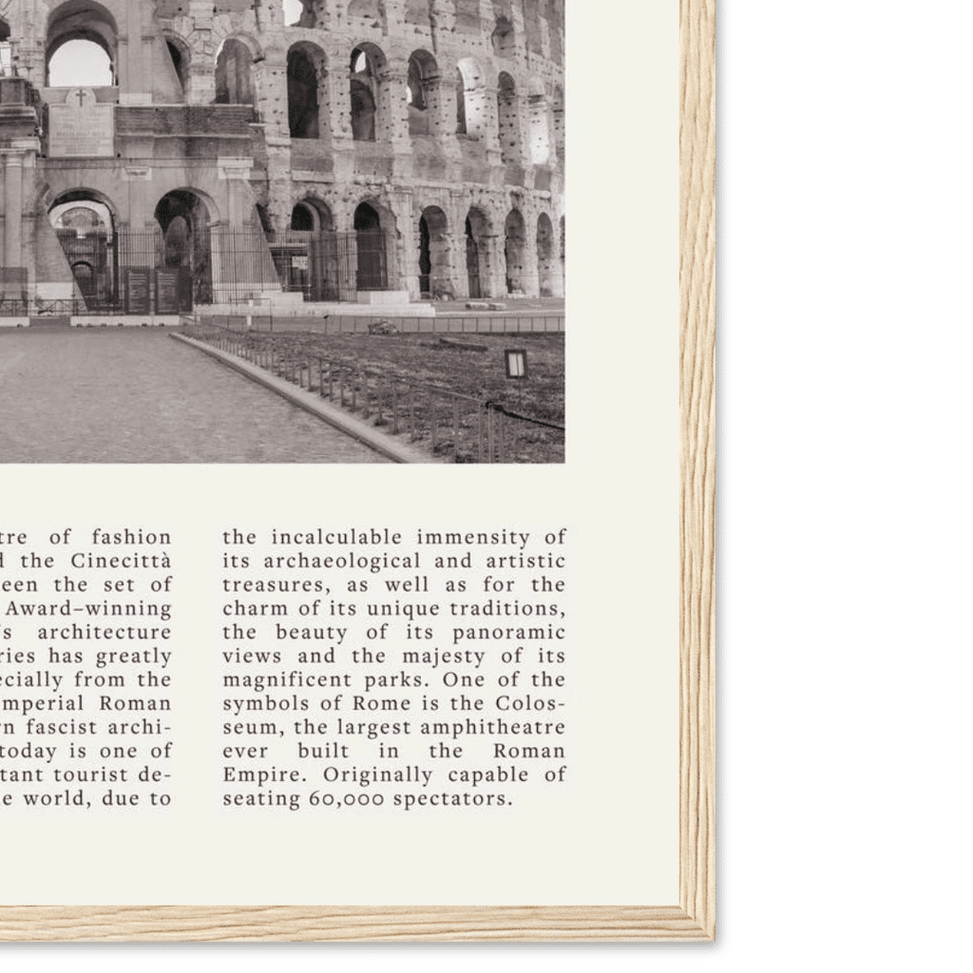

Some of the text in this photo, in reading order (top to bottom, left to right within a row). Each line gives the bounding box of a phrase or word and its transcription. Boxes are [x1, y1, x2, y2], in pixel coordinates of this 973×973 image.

[50, 528, 71, 544] of
[92, 528, 170, 544] fashion
[223, 528, 567, 550] the incalculable immensity of
[21, 552, 54, 568] the
[71, 552, 171, 568] Cinecittà
[224, 552, 565, 573] its archaeological and artistic
[54, 576, 87, 592] the
[104, 579, 134, 592] set
[151, 576, 173, 592] of
[223, 599, 565, 620] charm of its unique traditions,
[223, 623, 565, 645] the beauty of its panoramic
[49, 647, 82, 663] has
[96, 647, 171, 668] greatly
[223, 647, 565, 668] views and the majesty of its
[75, 671, 124, 687] from
[138, 671, 170, 687] the
[224, 671, 565, 692] magnificent parks. One of the
[100, 696, 170, 710] Roman
[27, 718, 96, 734] fascist
[109, 718, 170, 734] archi-
[224, 718, 565, 739] seum, the largest amphitheatre
[223, 742, 564, 758] ever built in the Roman
[54, 766, 127, 782] tourist
[138, 766, 170, 782] de-
[224, 765, 567, 787] Empire. Originally capable of
[23, 789, 91, 809] world,
[102, 789, 139, 806] due
[150, 793, 171, 805] to
[224, 790, 512, 810] seating 60,000 spectators.
